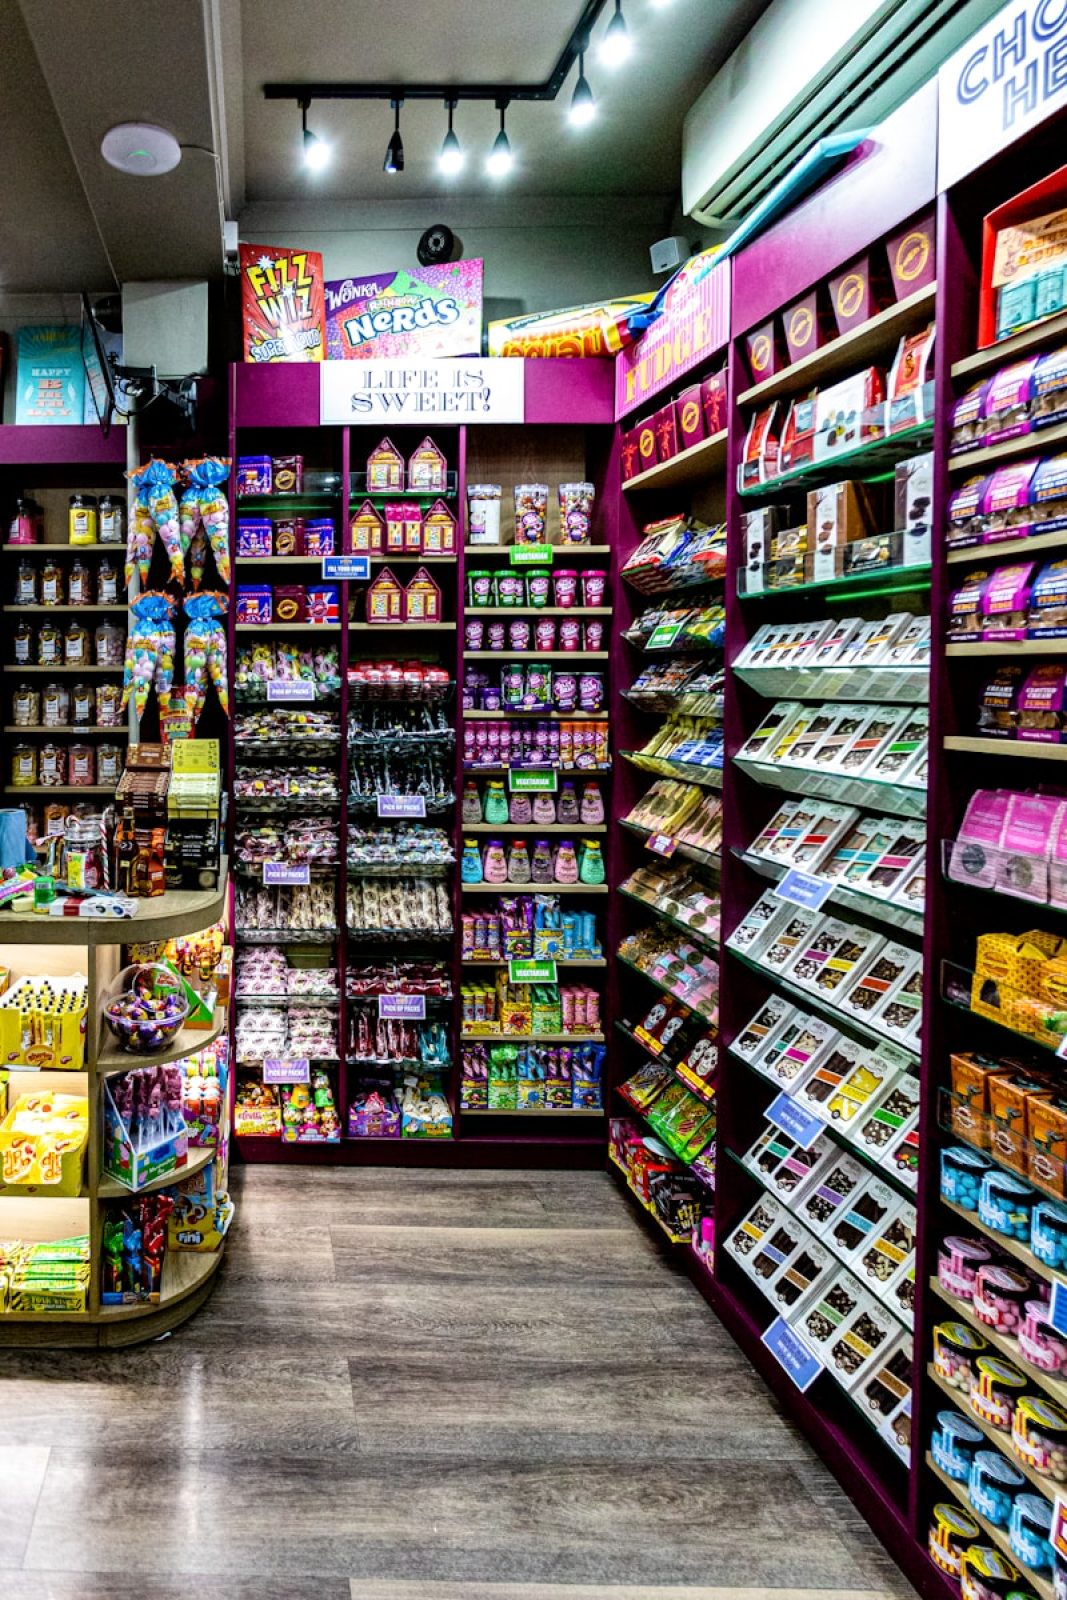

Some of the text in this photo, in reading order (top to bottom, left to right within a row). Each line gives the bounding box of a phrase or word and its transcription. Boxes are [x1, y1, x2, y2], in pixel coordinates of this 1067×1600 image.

[246, 254, 313, 297] FIZZ
[256, 288, 313, 328] WIZ
[328, 280, 380, 311] WONKA
[624, 306, 713, 404] FUDGE
[32, 367, 71, 377] HAPPY
[362, 370, 484, 388] LIFE IS
[350, 388, 491, 413] SWEET!
